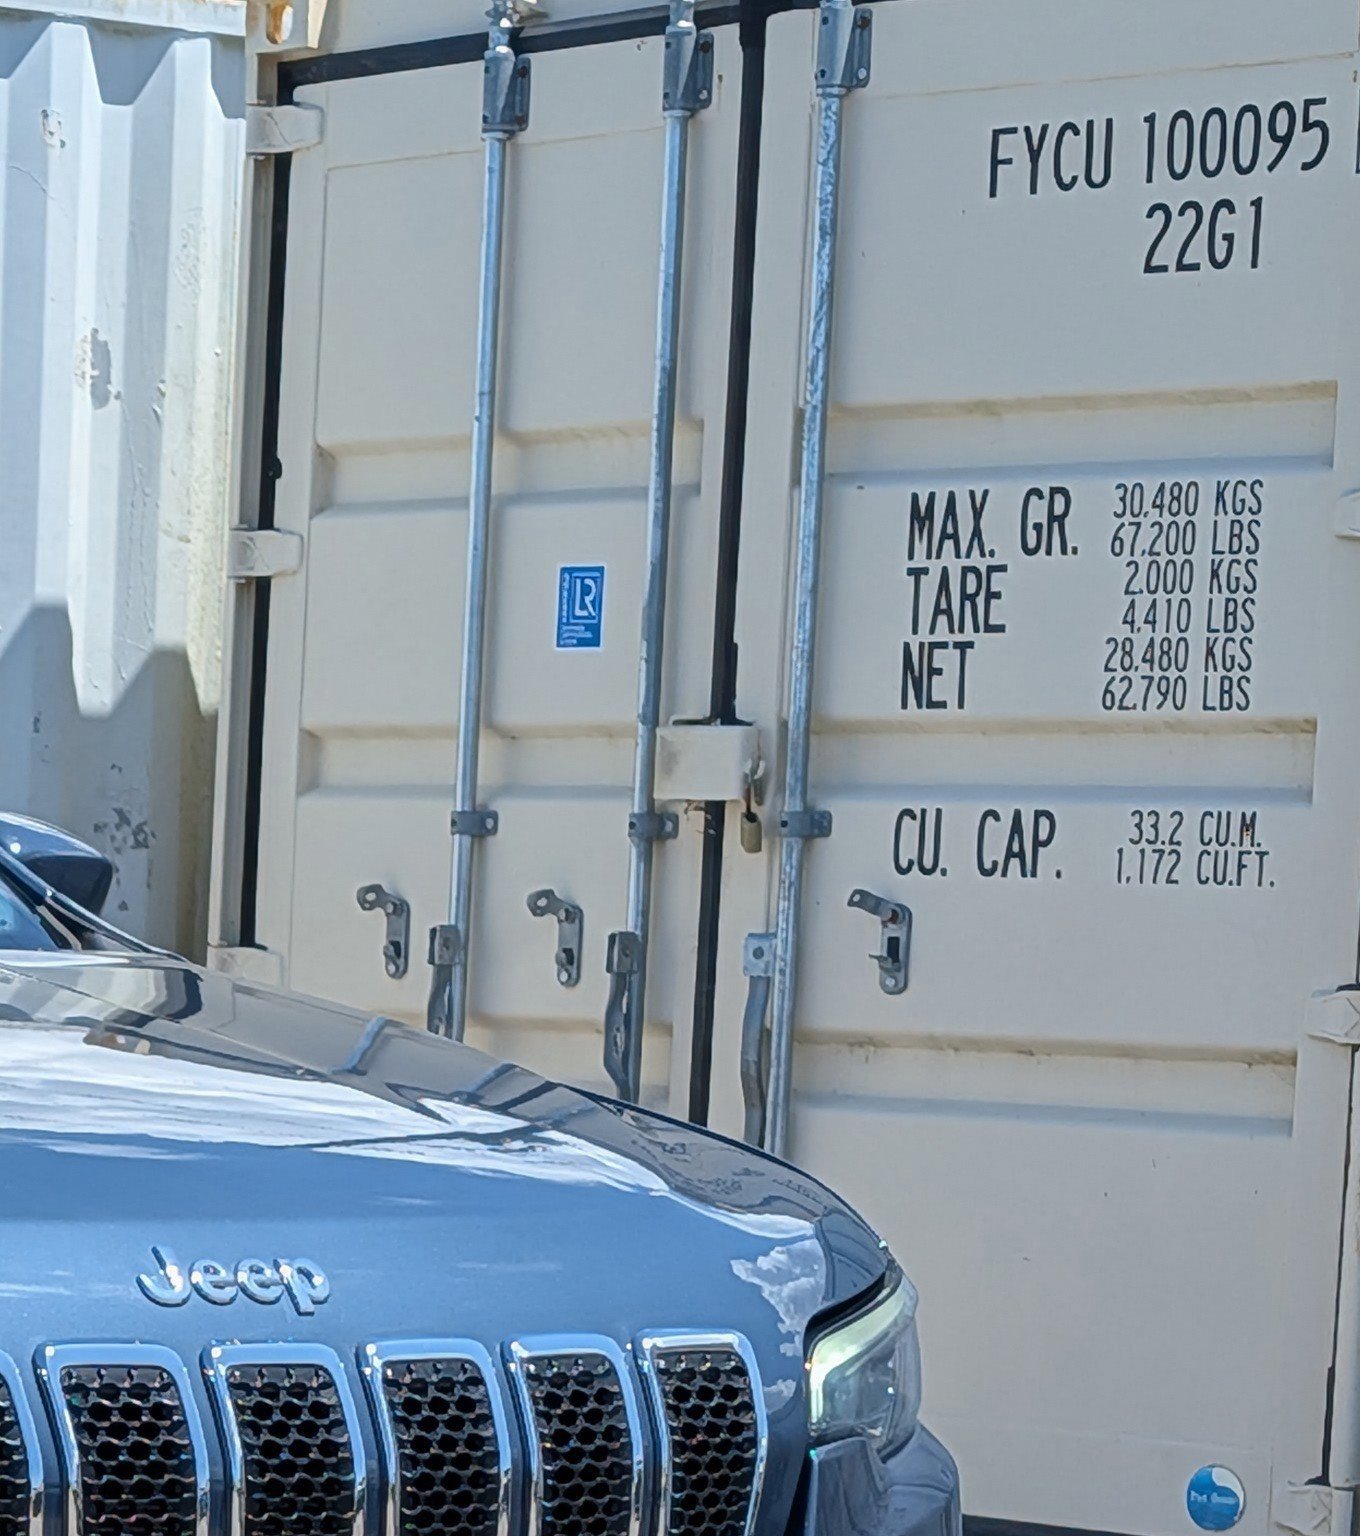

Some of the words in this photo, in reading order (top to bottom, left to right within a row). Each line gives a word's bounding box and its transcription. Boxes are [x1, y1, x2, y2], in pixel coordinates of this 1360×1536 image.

[989, 117, 1114, 199] FYCU
[1142, 97, 1330, 184] 100095
[1143, 196, 1264, 274] 22G1
[1113, 481, 1200, 519] 30.480
[1214, 479, 1264, 517] KGS
[907, 489, 996, 561] MAX.
[1020, 486, 1079, 556] GR.
[1110, 519, 1197, 558] 67.200
[1211, 519, 1261, 556] LBS
[1124, 558, 1194, 596] 2.000
[1209, 558, 1259, 595] KGS
[906, 564, 1008, 636] TARE
[1121, 597, 1192, 635] 4.410
[1206, 597, 1256, 634] LBS
[1104, 636, 1191, 674] 28.480
[1203, 635, 1254, 673] KGS
[900, 641, 975, 711] NET
[1101, 675, 1188, 712] 62.790
[1202, 675, 1251, 712] LBS
[893, 807, 948, 877] CU.
[976, 808, 1063, 880] CAP.
[1128, 809, 1185, 847] 33.2
[1199, 810, 1262, 848] CU.M.
[1116, 847, 1181, 885] 1.172
[1196, 849, 1276, 888] CU.FT.
[135, 1246, 332, 1317] Jeep
